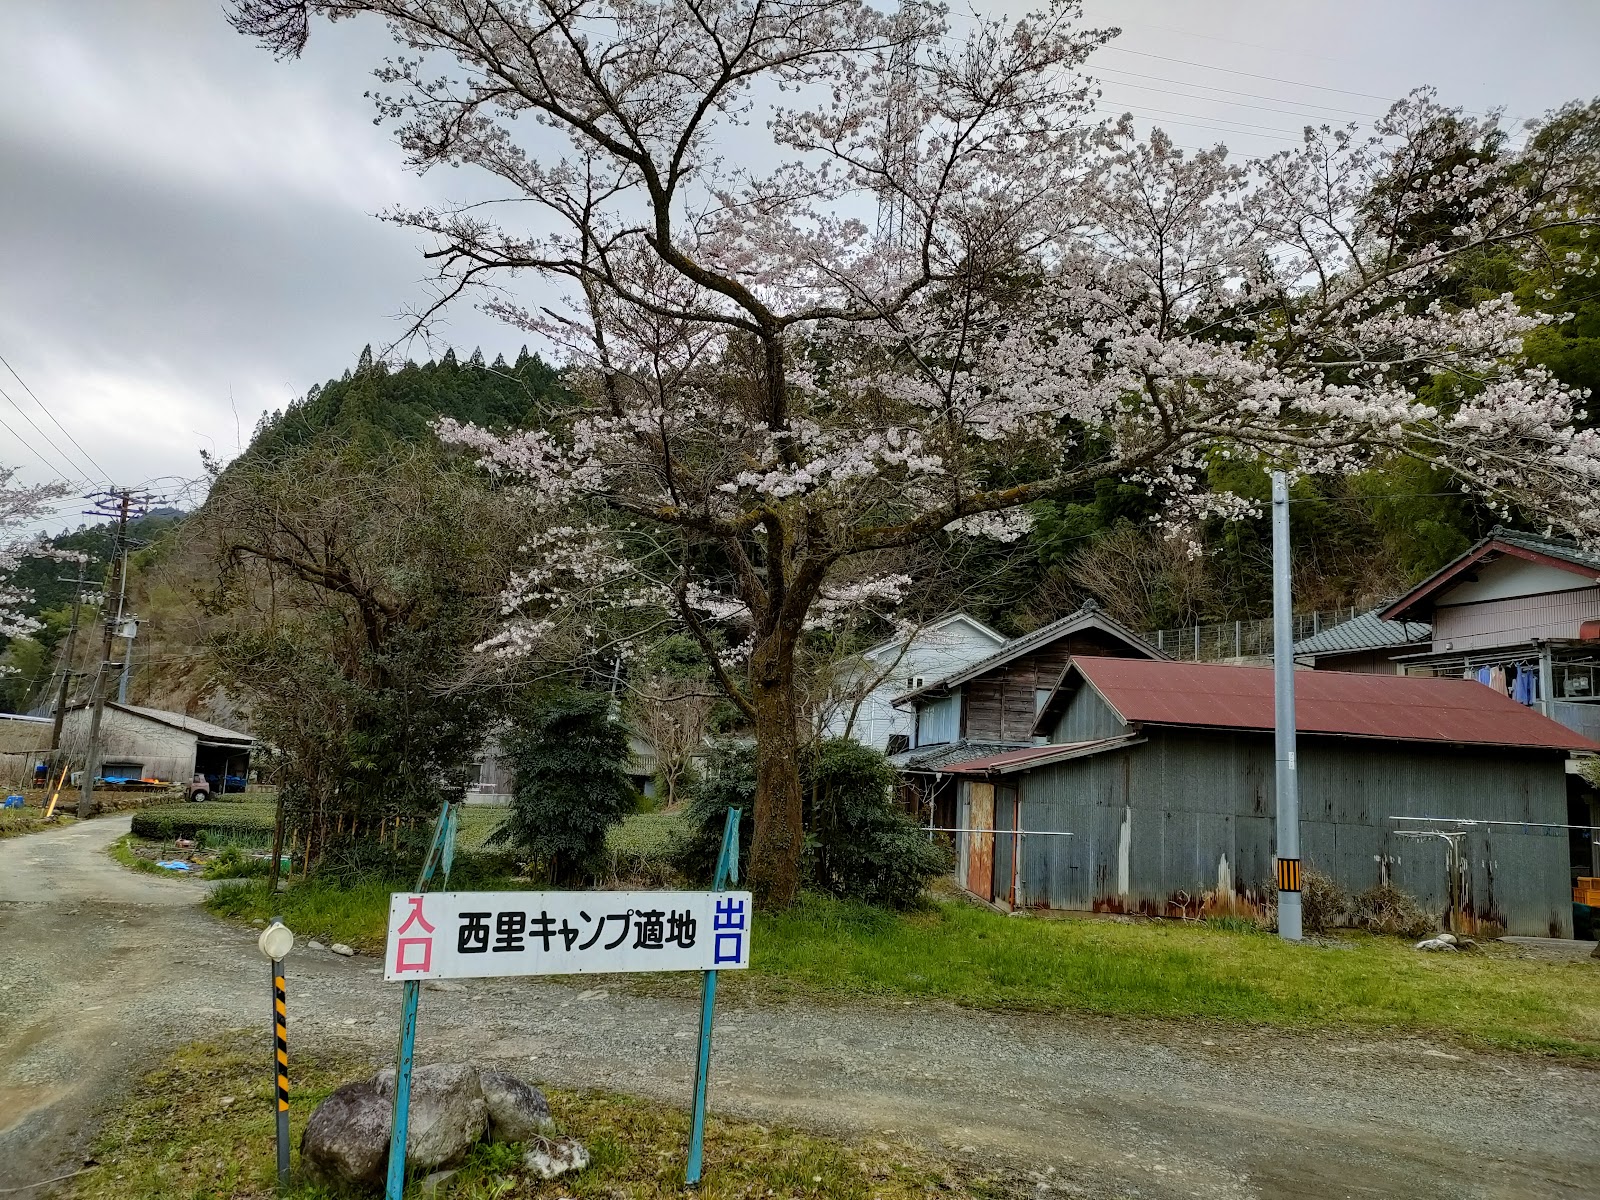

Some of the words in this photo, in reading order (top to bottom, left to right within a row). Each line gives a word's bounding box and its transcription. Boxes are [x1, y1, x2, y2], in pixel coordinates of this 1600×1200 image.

[395, 897, 436, 974] 入口
[457, 908, 697, 954] 西里キャンプ適地
[713, 897, 745, 965] 出口
